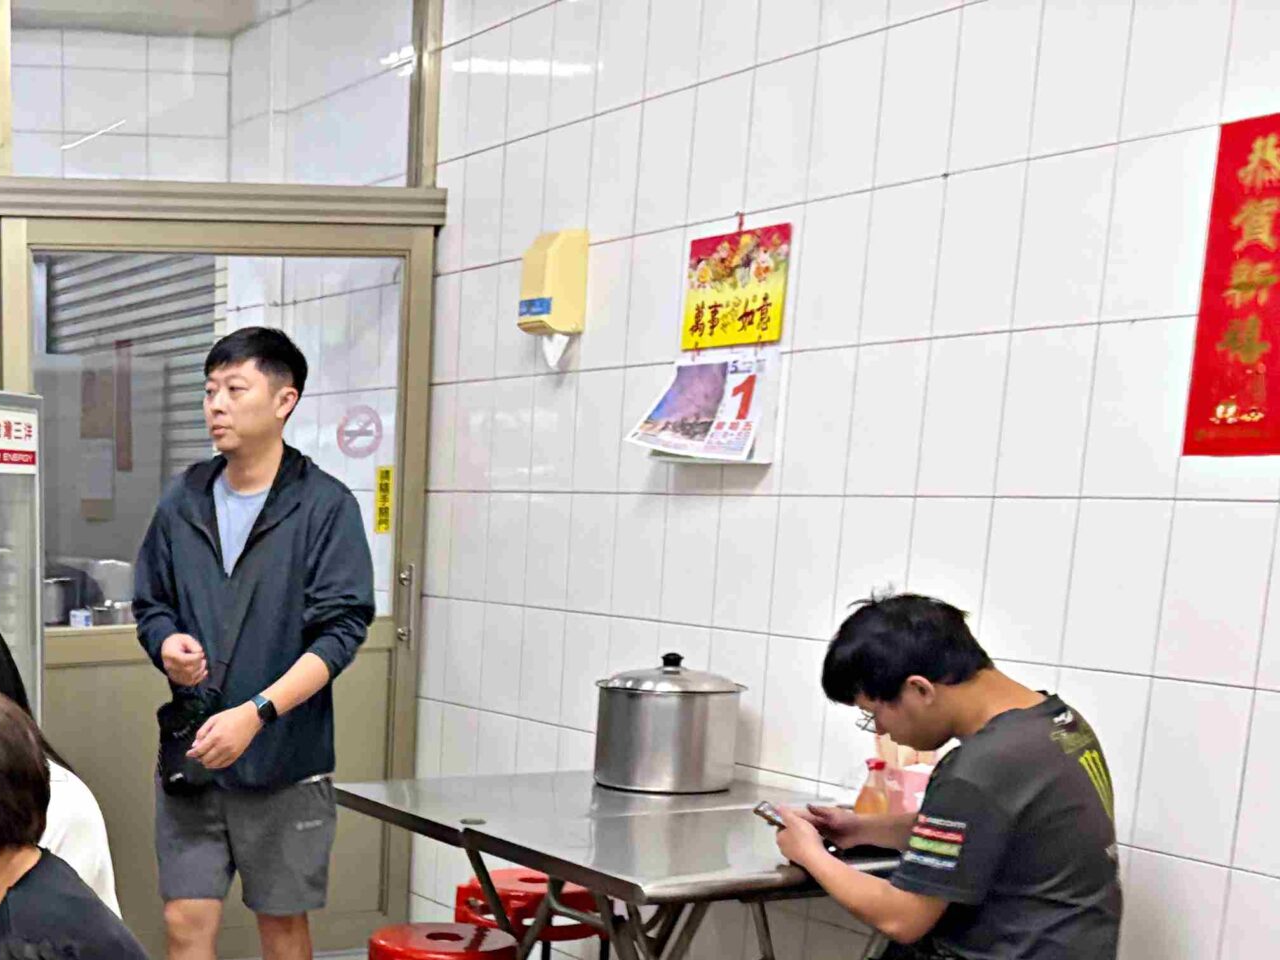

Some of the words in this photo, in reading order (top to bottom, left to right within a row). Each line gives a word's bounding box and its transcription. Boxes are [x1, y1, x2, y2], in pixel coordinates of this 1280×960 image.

[689, 293, 772, 338] 萬事如意
[731, 374, 757, 421] 1
[3, 452, 34, 463] ENERGY
